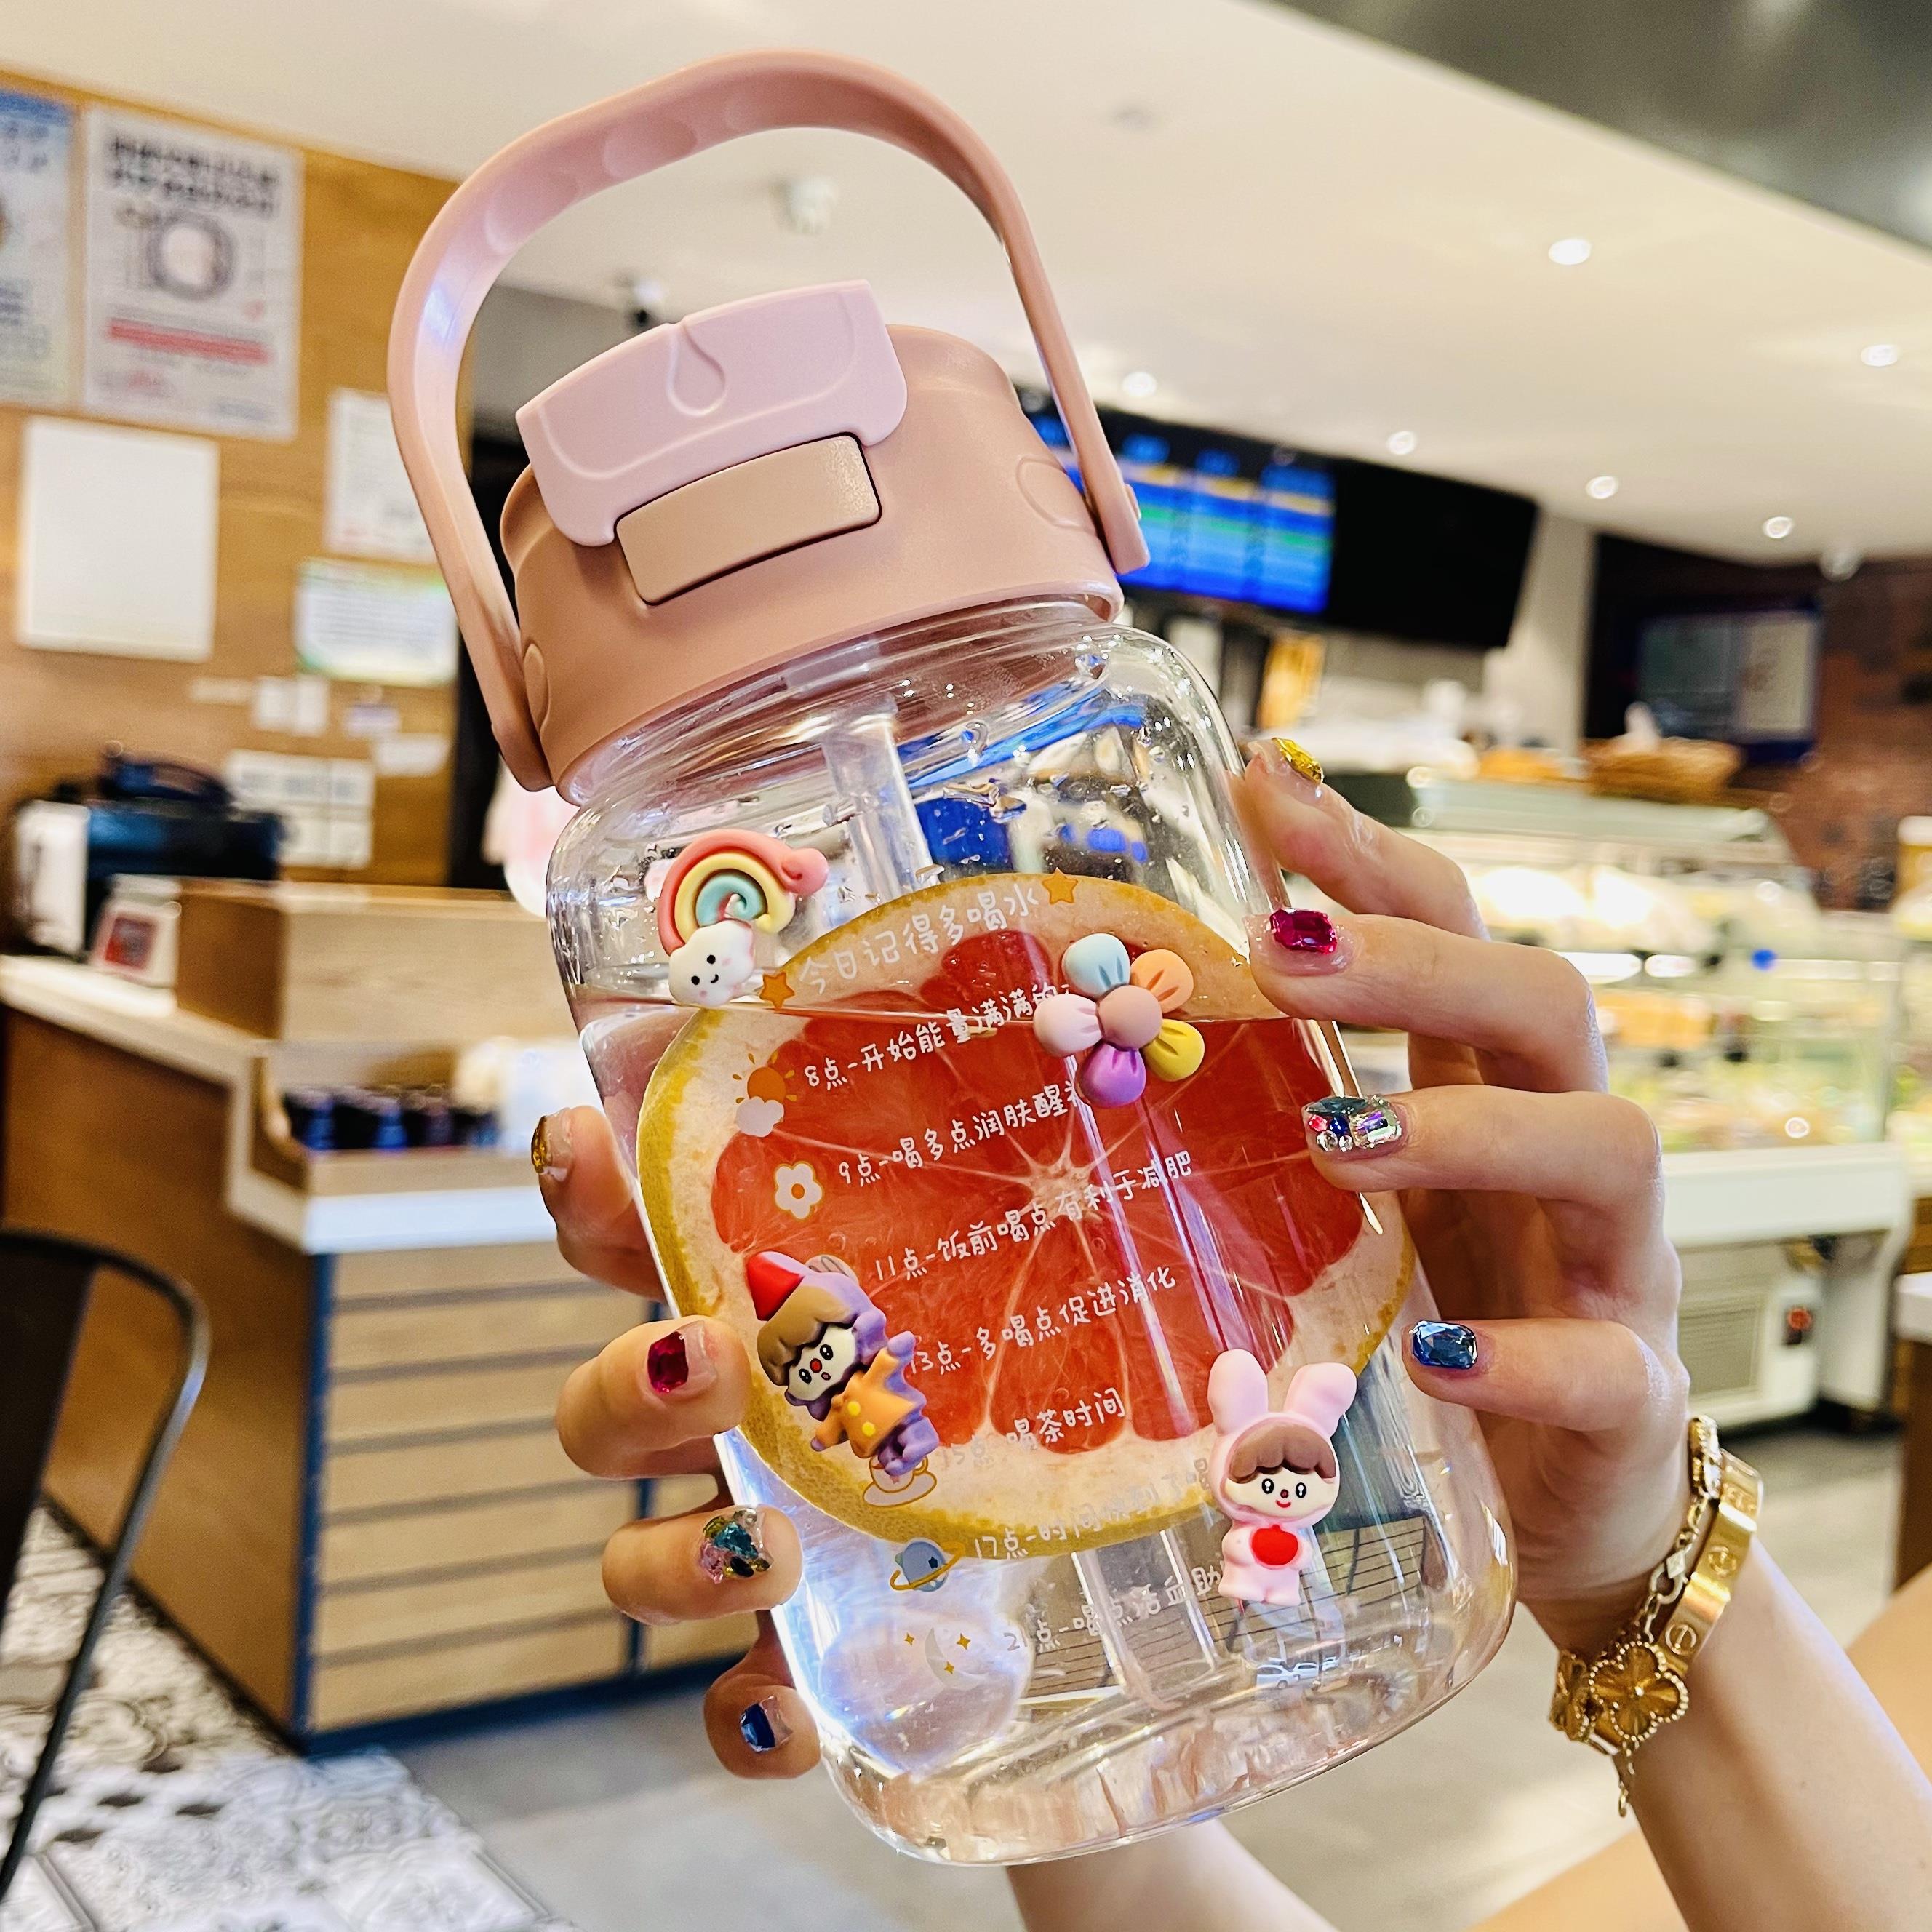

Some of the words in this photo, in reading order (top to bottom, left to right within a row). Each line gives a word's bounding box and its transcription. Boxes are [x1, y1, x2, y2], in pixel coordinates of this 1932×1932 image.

[799, 884, 1038, 994] 今日记得多喝水
[805, 981, 1070, 1091] 8点-开始能量满满的
[875, 1150, 1193, 1281] 11点-饭前喝点有利于减肥
[910, 1266, 1176, 1375] 13点-多喝点促进消化
[1003, 1560, 1224, 1653] 21点-喝点活血助
